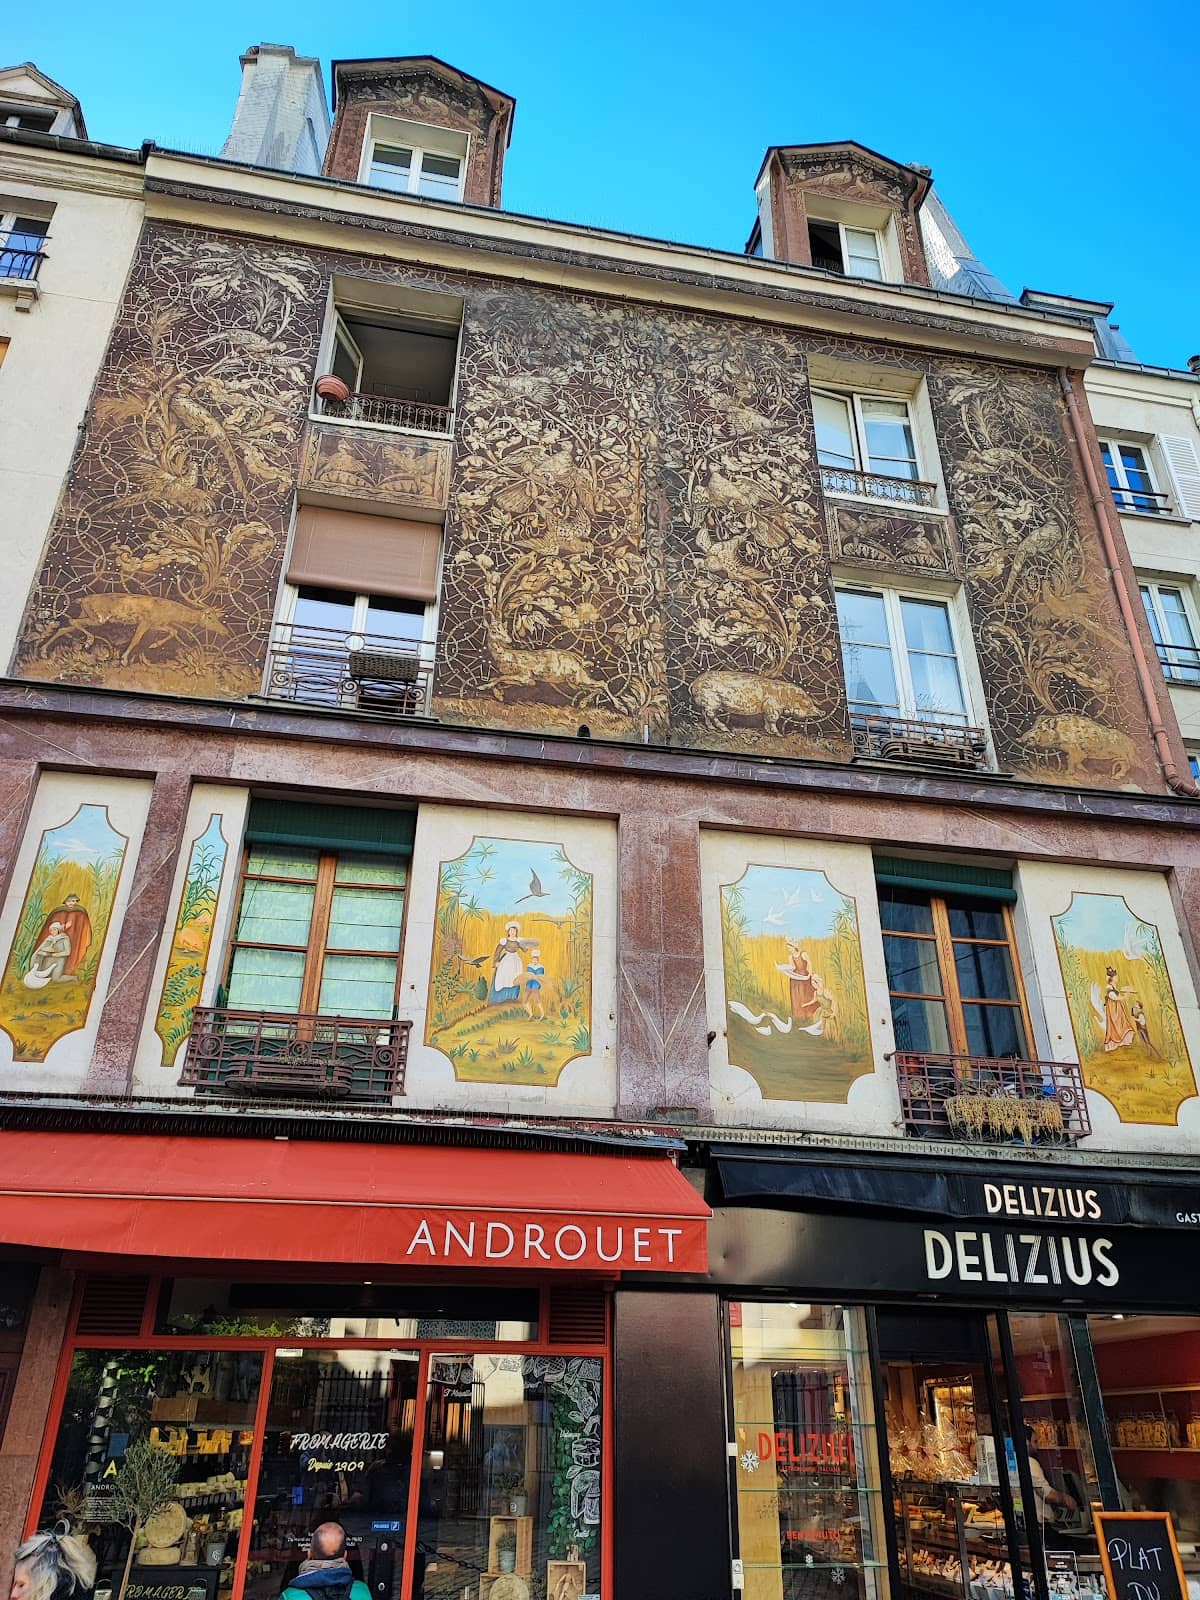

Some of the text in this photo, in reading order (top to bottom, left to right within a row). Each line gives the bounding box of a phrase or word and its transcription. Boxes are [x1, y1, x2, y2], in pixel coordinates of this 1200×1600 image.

[983, 1183, 1102, 1220] DELIZIUS
[406, 1219, 683, 1263] ANDROUET
[923, 1229, 1120, 1287] DELIZIUS
[289, 1432, 390, 1451] FROMAGERIE
[102, 1459, 118, 1479] A
[307, 1457, 365, 1473] Depuis 1909
[1107, 1537, 1163, 1572] PLAT
[1127, 1581, 1161, 1600] DU
